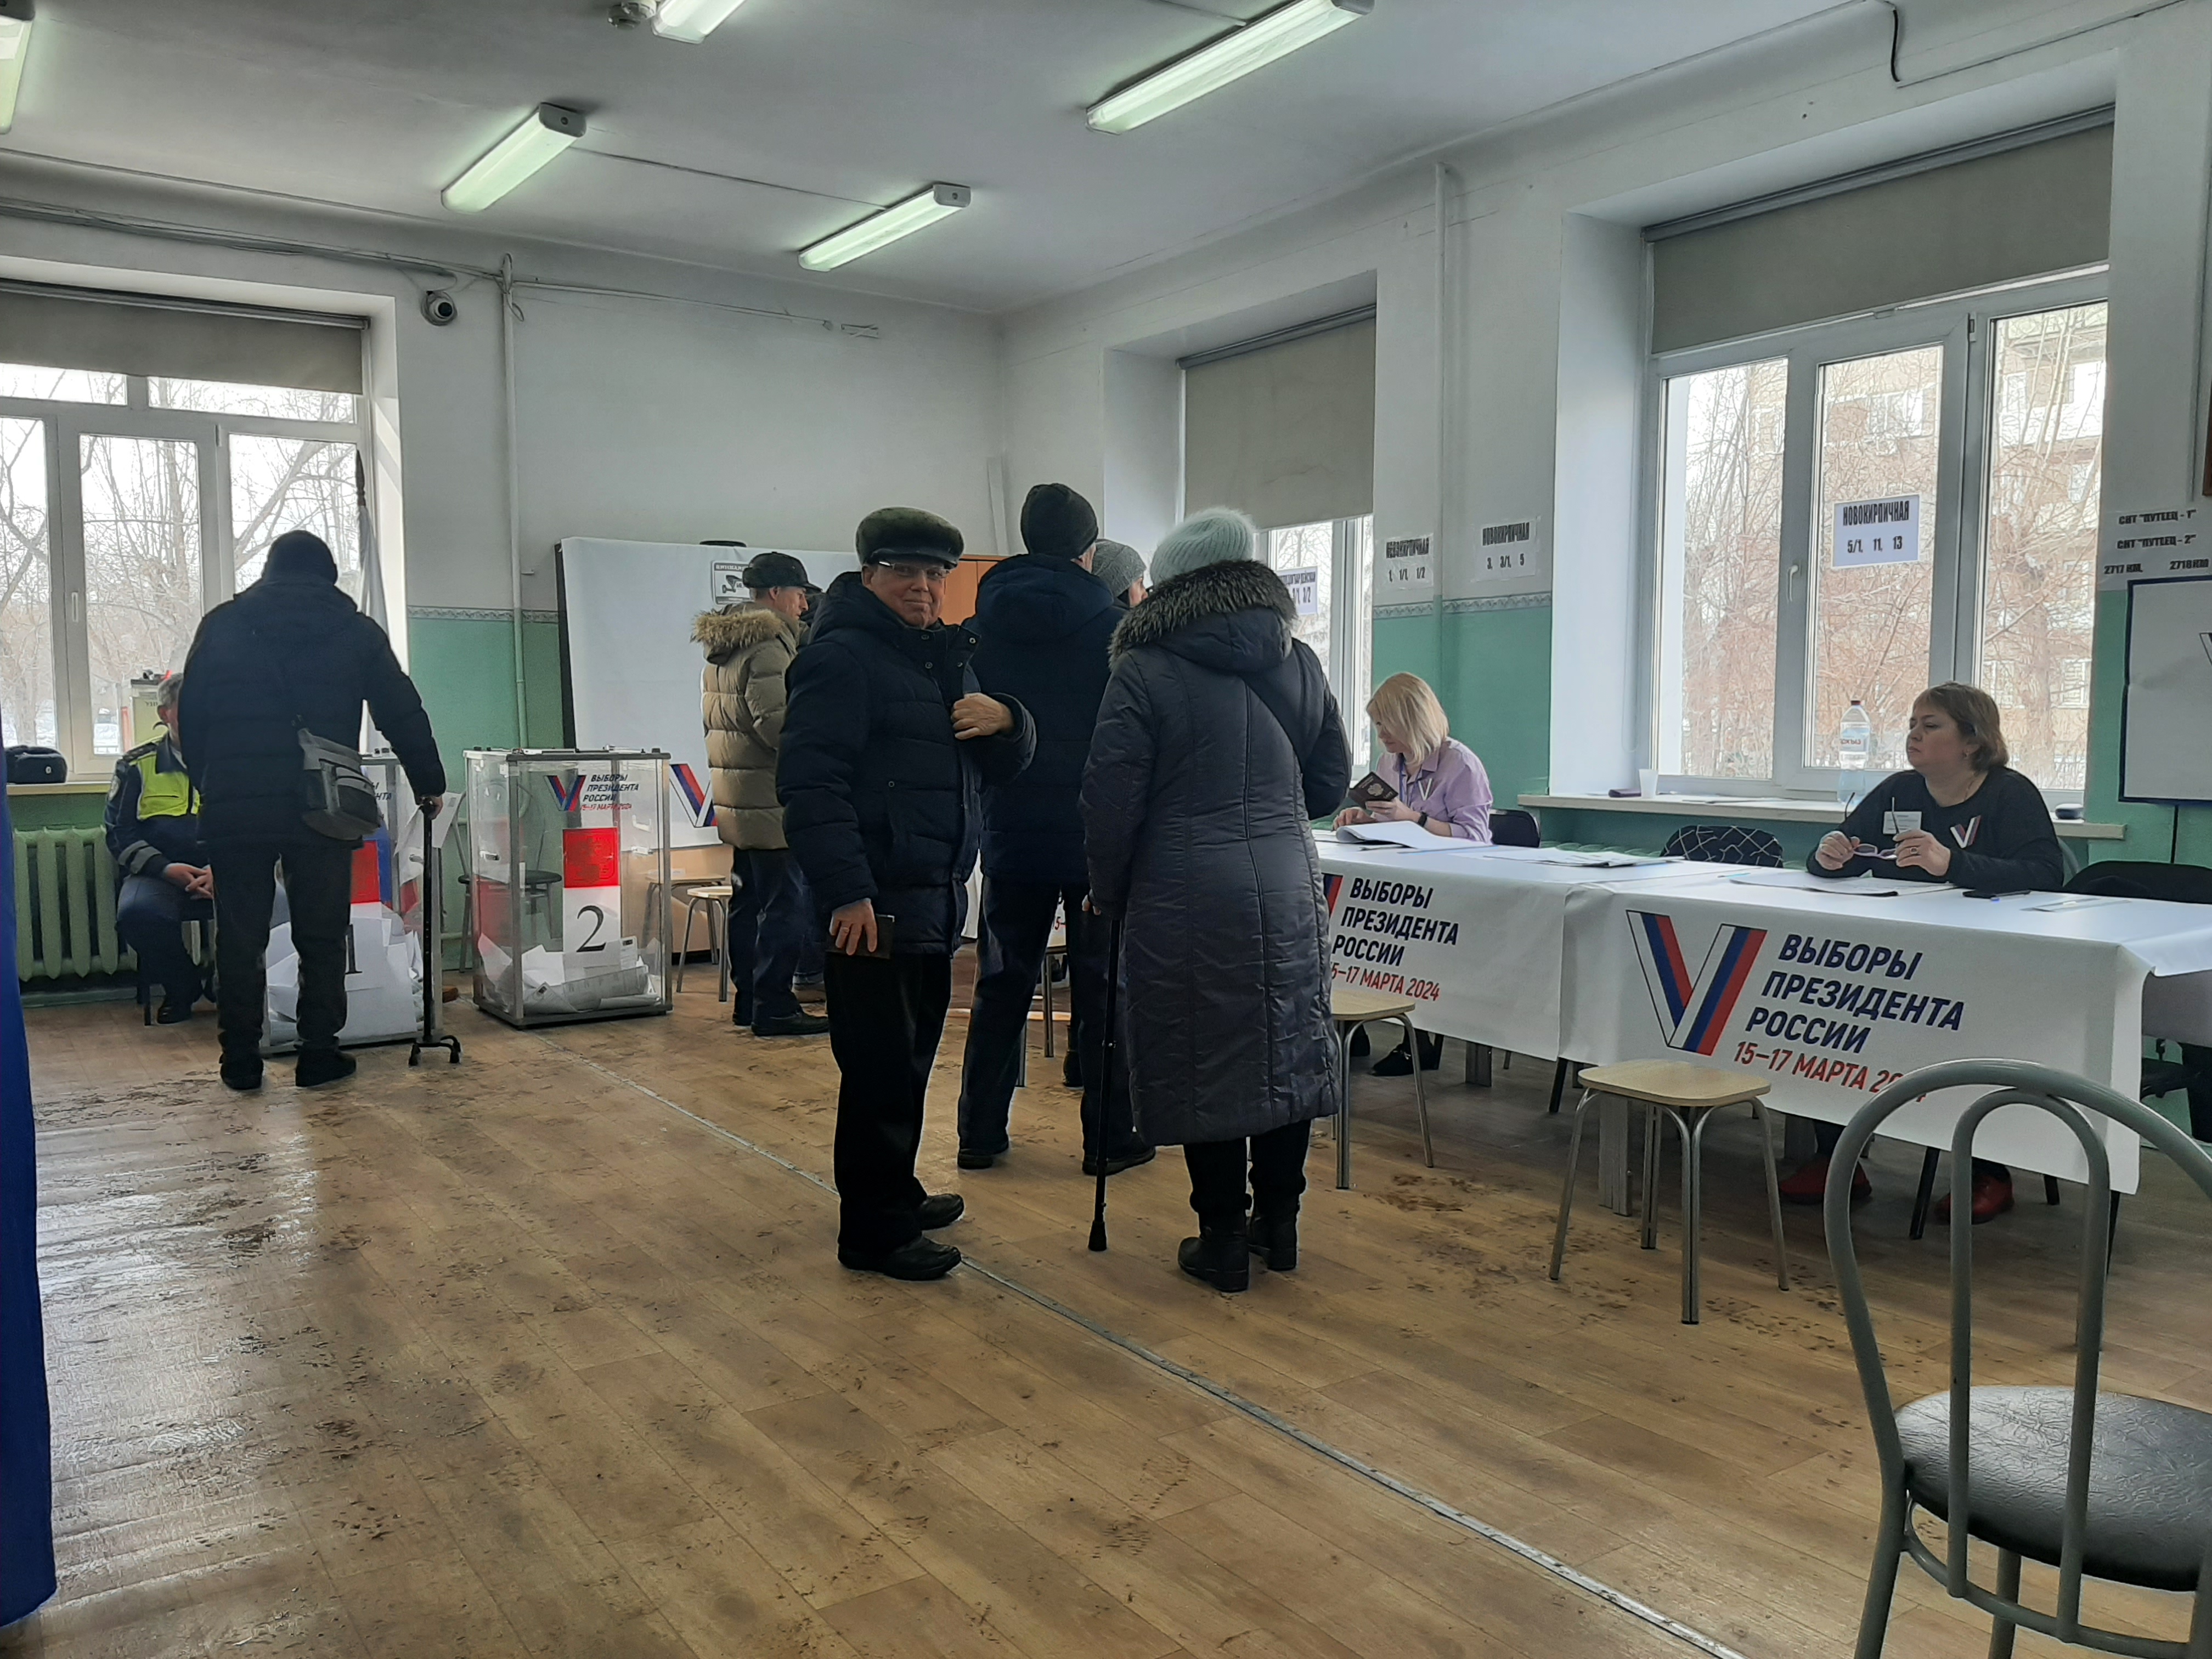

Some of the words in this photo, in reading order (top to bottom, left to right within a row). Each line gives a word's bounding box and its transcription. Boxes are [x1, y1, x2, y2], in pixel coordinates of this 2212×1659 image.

[1842, 500, 1910, 526] НОВОКИРПИЧНАЯ
[2118, 515, 2138, 524] СНТ
[1893, 535, 1903, 550] 13
[2117, 539, 2136, 549] СНТ
[1520, 553, 1525, 566] 5
[2104, 565, 2124, 574] 2717
[2169, 560, 2193, 570] 2718
[587, 783, 639, 792] ПРЕЗИДЕНТА
[1350, 877, 1434, 909] ВЫБОРЫ
[576, 905, 606, 952] 2
[1341, 906, 1459, 945] ПРЕЗИДЕНТА
[1332, 934, 1405, 967] РОССИИ
[1778, 934, 1923, 980] ВЫБОРЫ
[1330, 961, 1360, 984] 5–17
[1359, 968, 1404, 994] МАРТА
[1405, 978, 1440, 1001] 2024
[1760, 970, 1966, 1031] ПРЕЗИДЕНТА
[1745, 1007, 1871, 1054] РОССИИ
[1792, 1053, 1869, 1090] МАРТА
